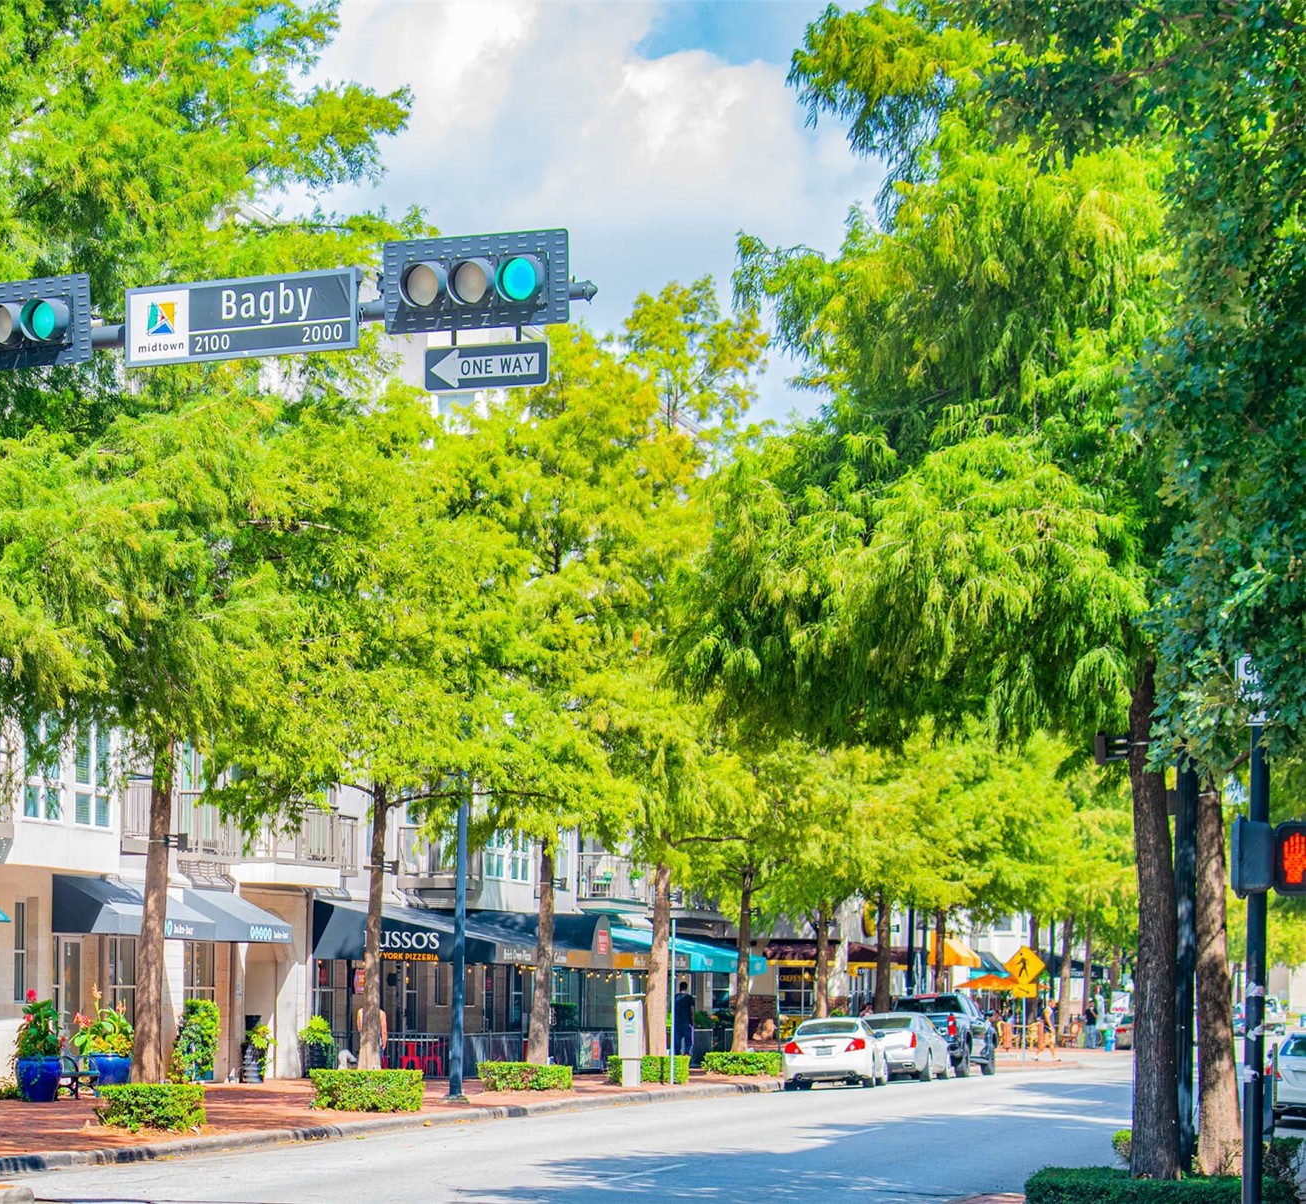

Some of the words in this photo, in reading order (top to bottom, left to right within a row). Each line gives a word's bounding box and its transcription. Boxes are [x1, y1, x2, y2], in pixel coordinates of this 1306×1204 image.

[221, 282, 313, 325] Bagby
[302, 323, 343, 342] 2000
[137, 341, 185, 353] midtown
[194, 334, 230, 352] 2100
[460, 358, 493, 376] ONE
[500, 356, 534, 374] WAY
[363, 930, 440, 950] USSO'S
[405, 953, 439, 961] PIZZERIA
